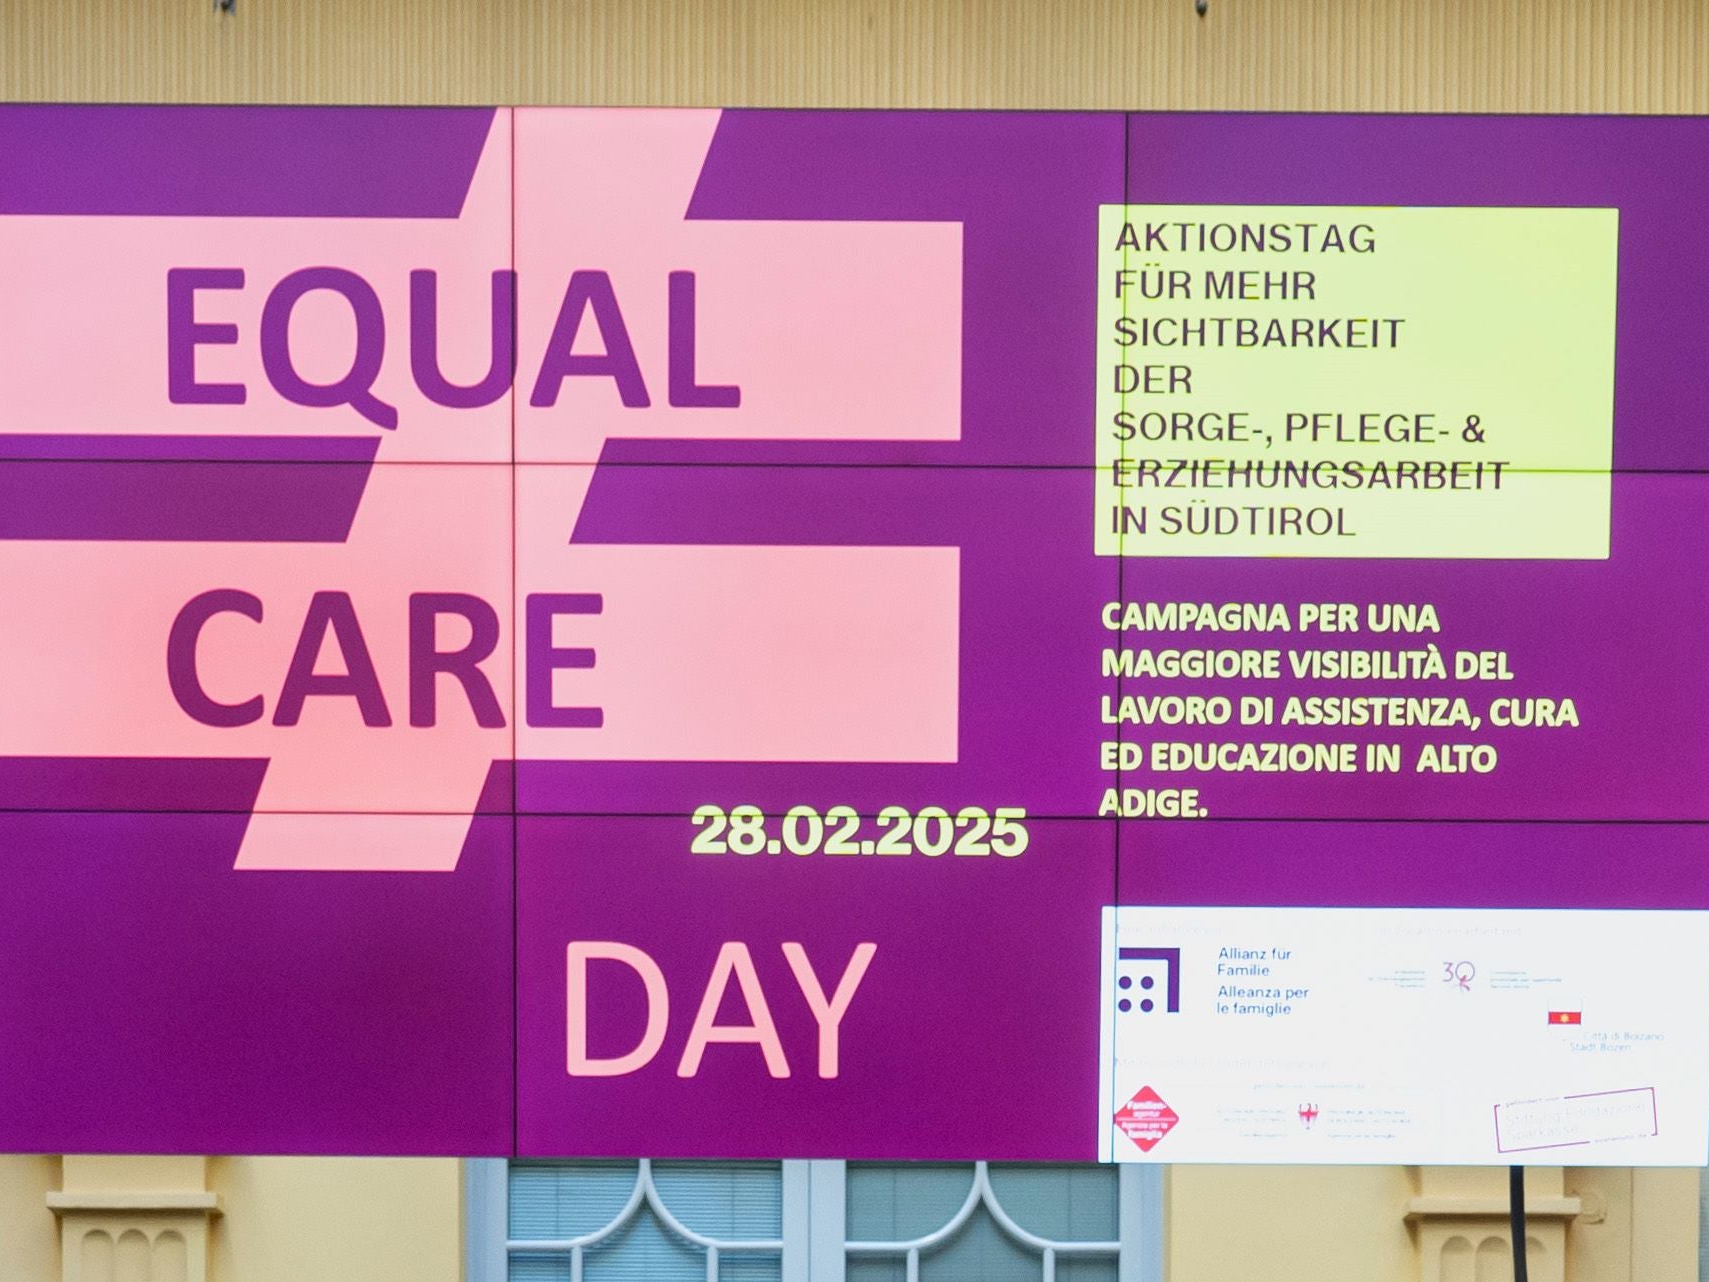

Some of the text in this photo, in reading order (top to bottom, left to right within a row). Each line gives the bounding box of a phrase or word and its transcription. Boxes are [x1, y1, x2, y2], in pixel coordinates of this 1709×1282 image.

[1115, 222, 1377, 254] AKTIONSTAG
[1114, 262, 1316, 301] FÜR MEHR
[167, 265, 741, 431] EQUAL
[1113, 317, 1406, 349] SICHTBARKEIT
[1113, 365, 1193, 395] DER
[1112, 412, 1487, 448] SORGE-, PFLEGE- &
[1112, 459, 1510, 490] ERZIEHUNGSARBEIT
[1111, 499, 1356, 537] IN SÜDTIROL
[1101, 602, 1440, 633] CAMPAGNA PER UNA
[166, 588, 604, 729] CARE
[1101, 643, 1513, 681] MAGGIORE VISIBILITÀ DEL
[1101, 696, 1579, 732] LAVORO DI ASSISTENZA, CURA
[1101, 742, 1497, 774] ED EDUCAZIONE IN ALTO
[1099, 789, 1208, 818] ADIGE.
[690, 804, 1029, 857] 28.02.2025
[1217, 963, 1270, 976] Familie
[1219, 947, 1266, 960] Allianz
[566, 940, 877, 1078] DAY
[1218, 985, 1309, 1001] Alleanza per
[1233, 1002, 1292, 1018] famiglie
